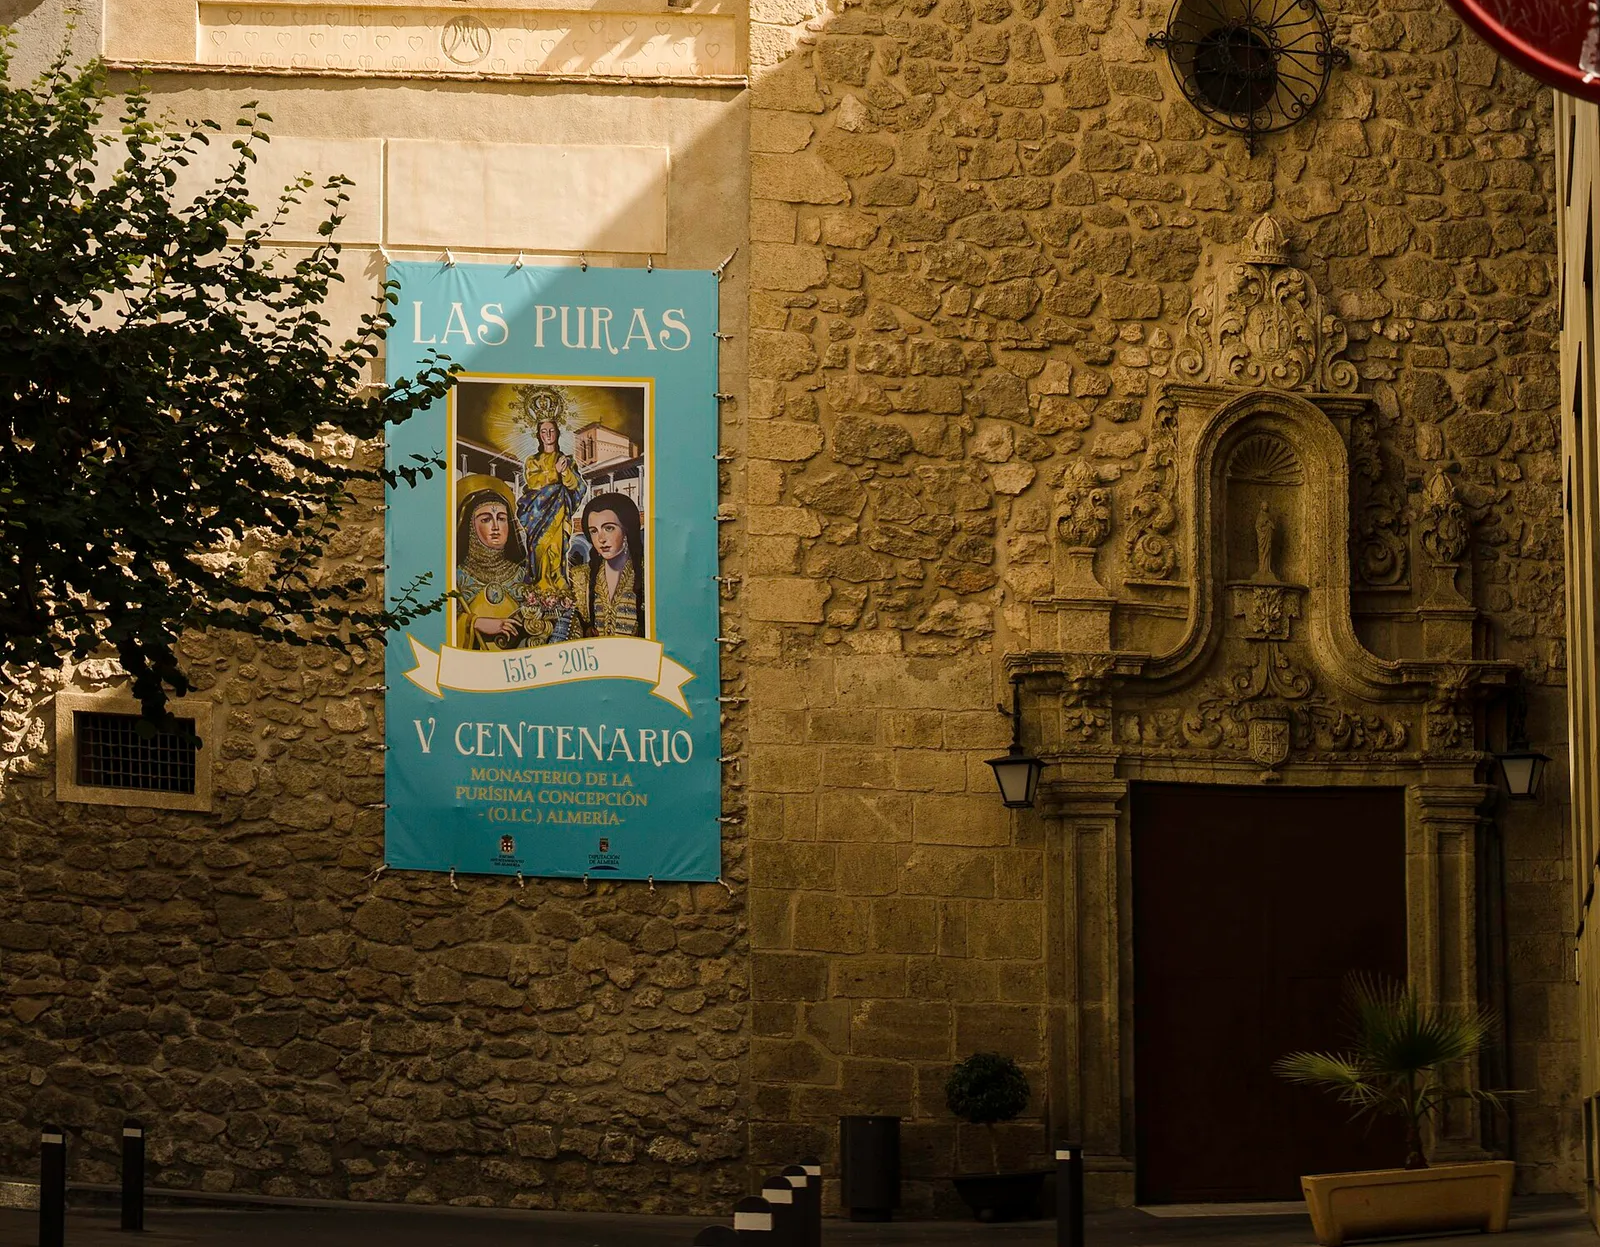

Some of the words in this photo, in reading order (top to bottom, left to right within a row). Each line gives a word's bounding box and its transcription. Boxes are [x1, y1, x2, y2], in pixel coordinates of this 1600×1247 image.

[412, 301, 509, 346] LAS
[534, 305, 692, 355] PURAS
[502, 654, 537, 683] 1515
[559, 646, 599, 675] 2015
[413, 717, 436, 753] V
[454, 721, 694, 766] CENTENARIO
[470, 768, 581, 786] MONASTERIO
[585, 773, 607, 786] DE
[612, 773, 633, 787] LA
[455, 784, 534, 803] PURÍSIMA
[537, 790, 648, 806] CONCEPCIÓN
[488, 808, 543, 824] (O.I.C.)
